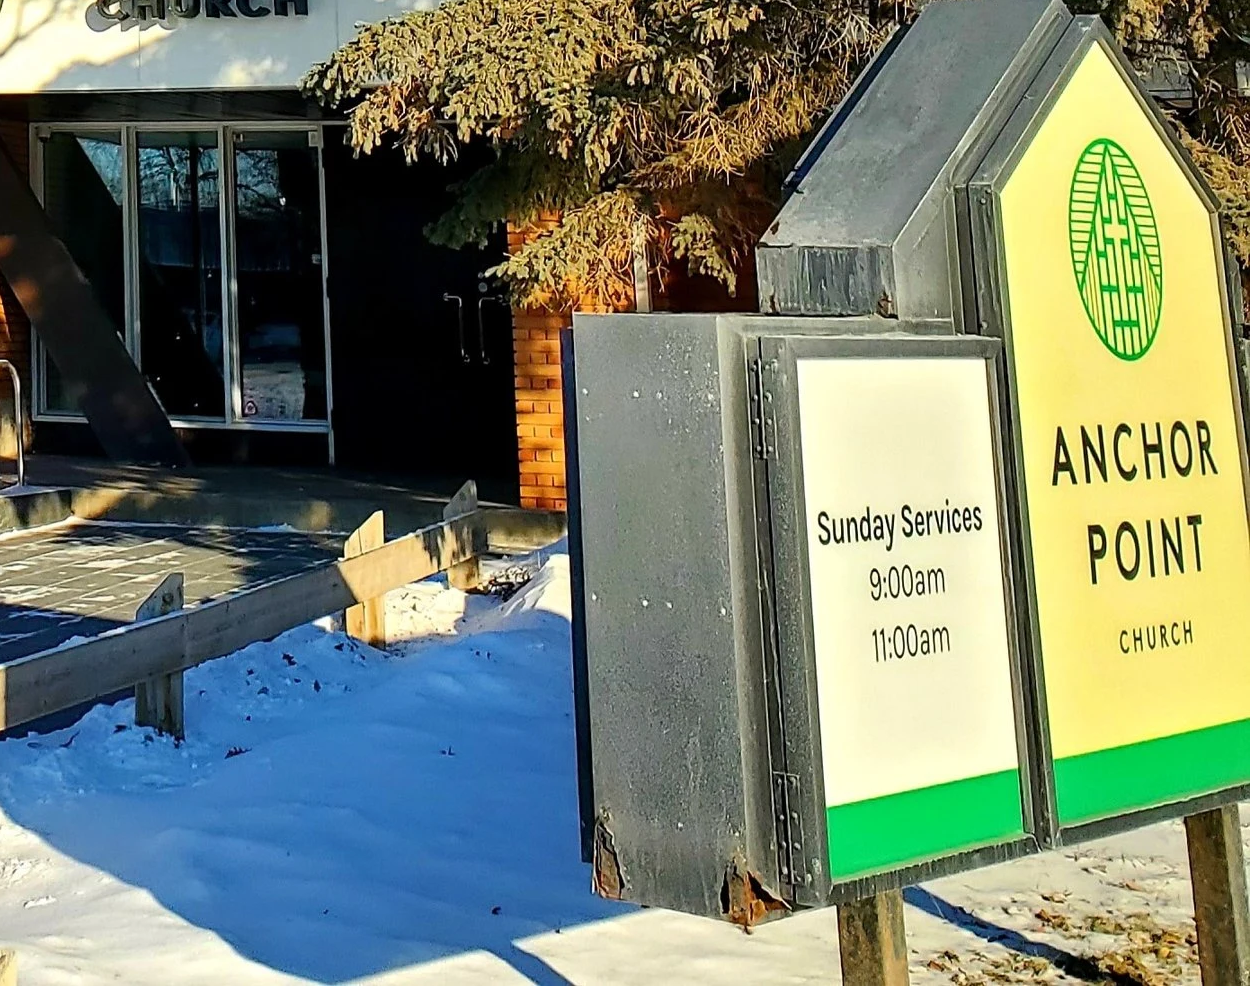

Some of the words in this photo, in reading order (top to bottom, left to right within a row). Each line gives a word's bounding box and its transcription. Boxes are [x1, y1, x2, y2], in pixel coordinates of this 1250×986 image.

[1051, 420, 1219, 487] ANCHOR
[817, 506, 896, 552] Sunday
[900, 498, 983, 538] Services
[1087, 514, 1203, 585] POINT
[869, 564, 946, 602] 9:00am
[871, 623, 951, 663] 11:00am
[1119, 620, 1193, 654] CHURCH
